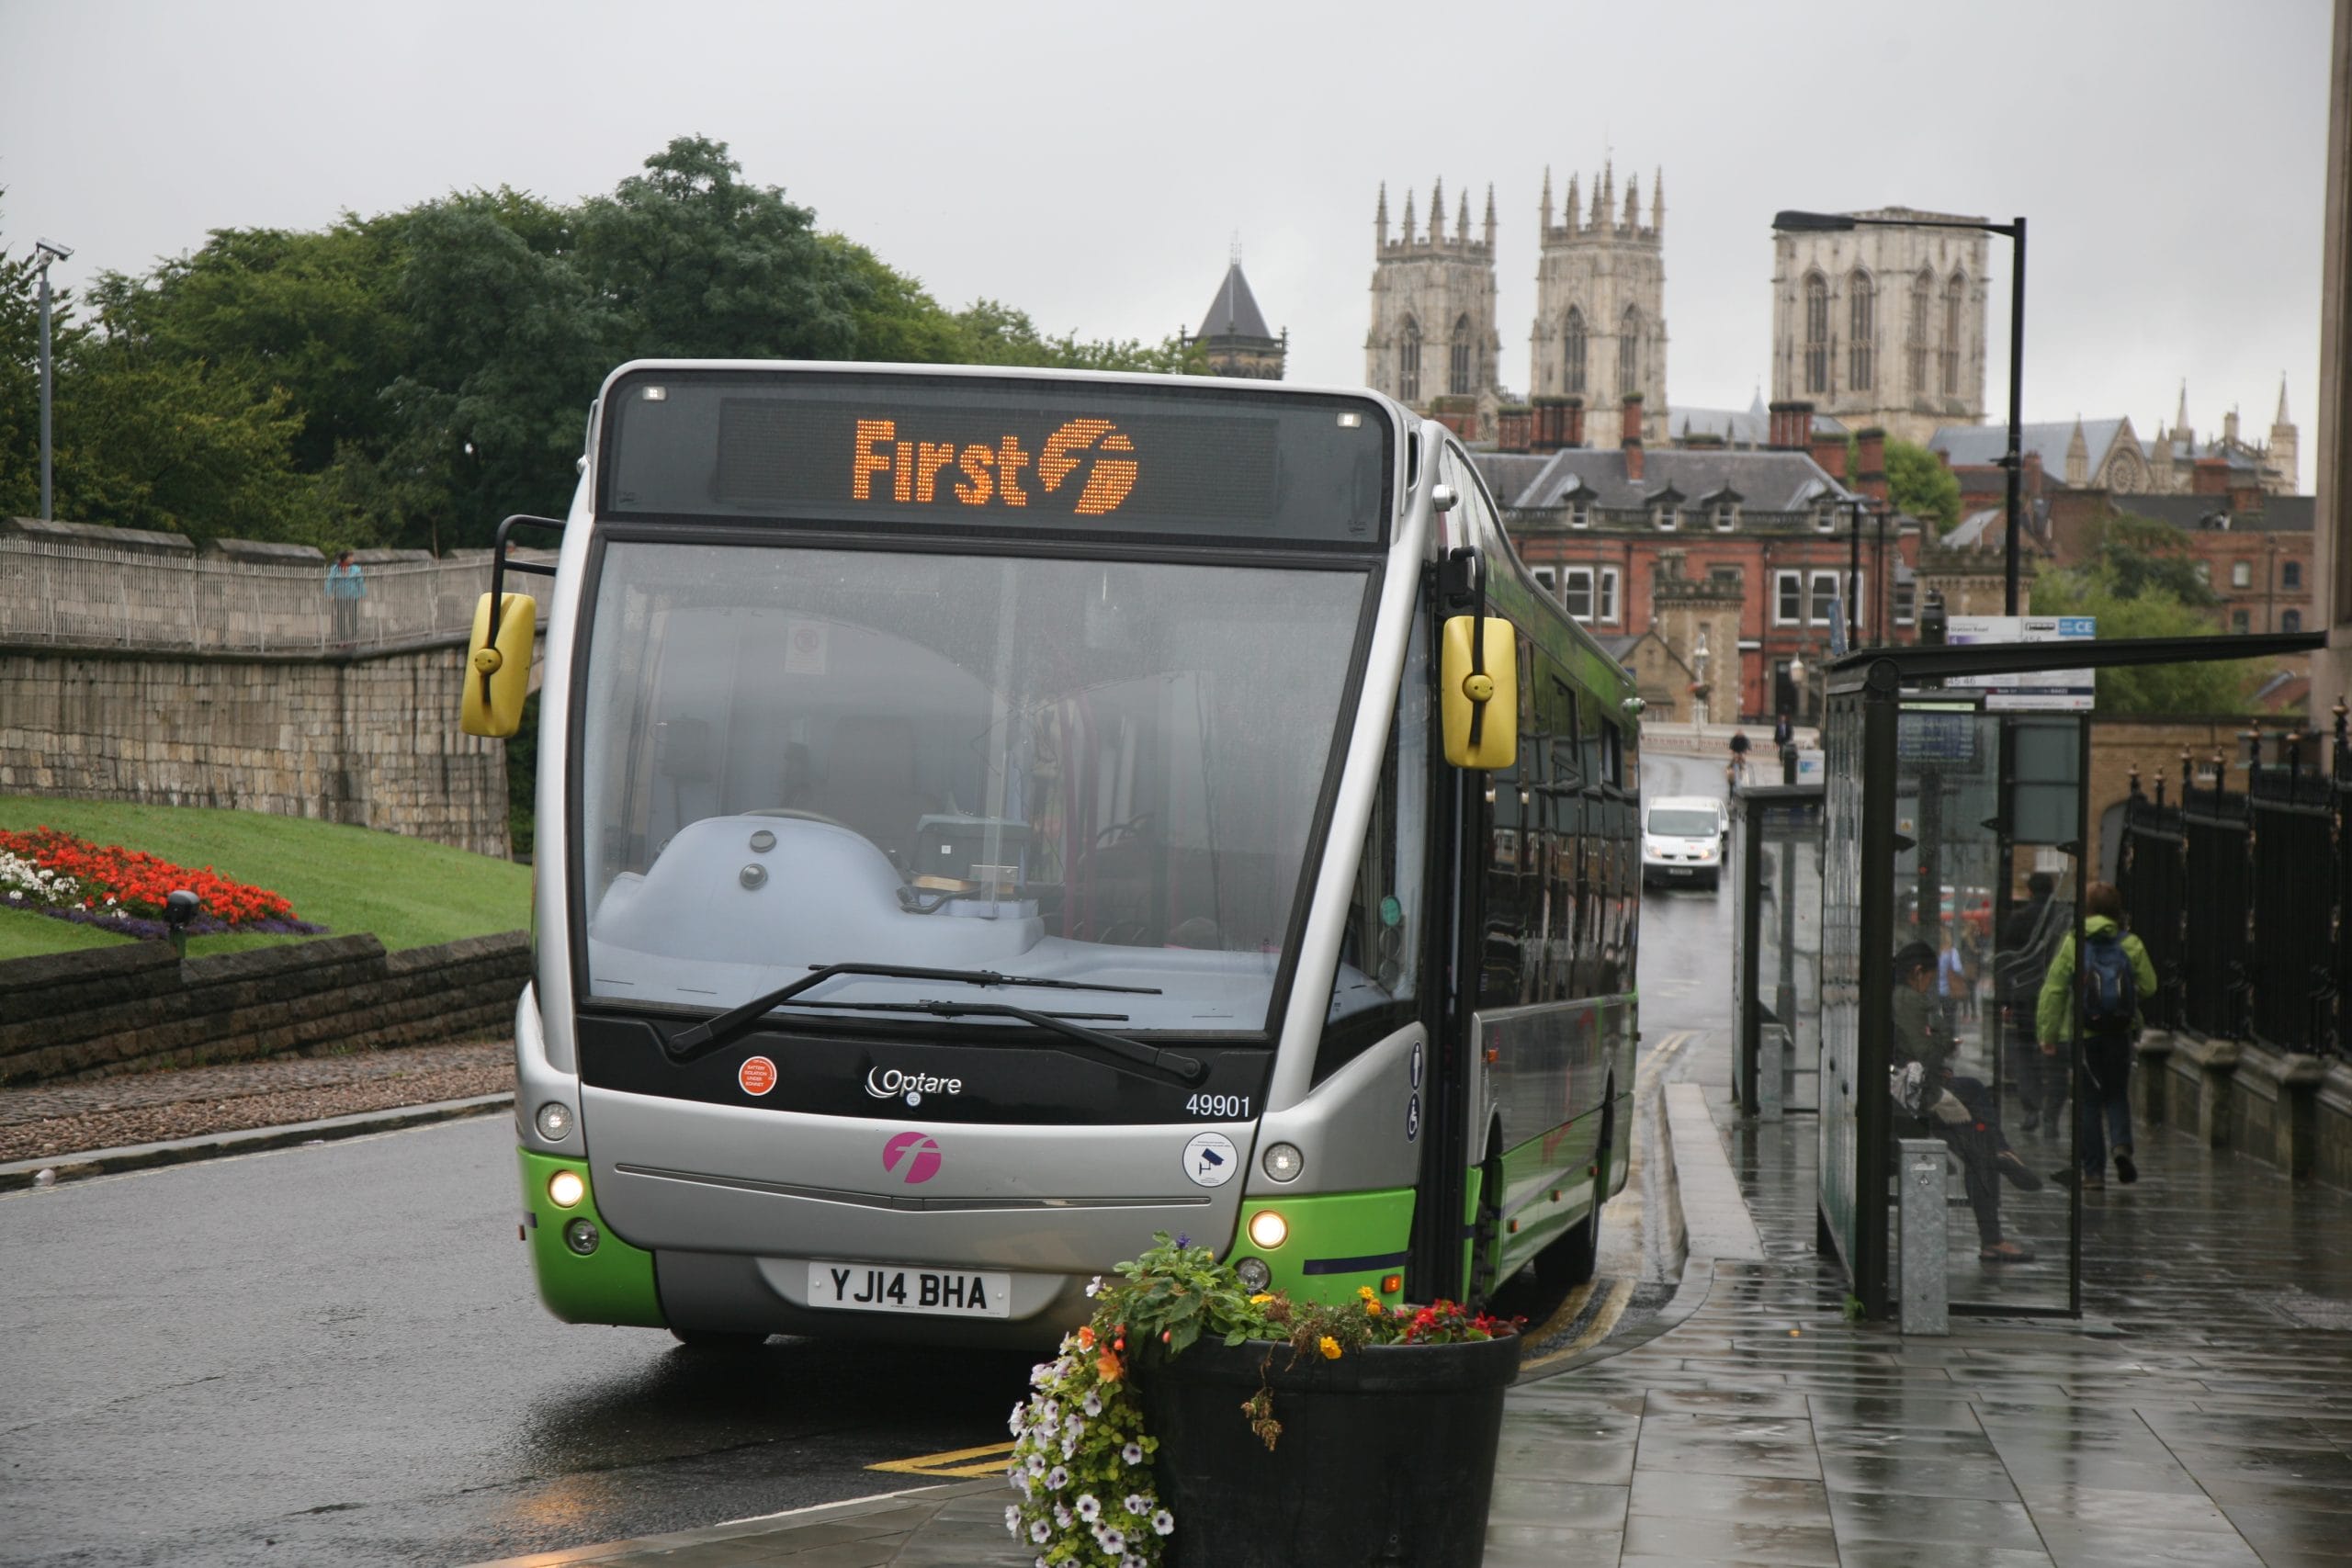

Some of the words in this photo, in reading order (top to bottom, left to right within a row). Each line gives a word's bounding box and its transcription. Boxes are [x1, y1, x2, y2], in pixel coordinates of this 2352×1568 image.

[854, 420, 1029, 505] First
[2075, 621, 2094, 633] CE
[883, 1069, 962, 1098] Optare
[1185, 1093, 1250, 1118] 49901
[831, 1268, 908, 1305] YJ14
[918, 1273, 988, 1310] BHA
